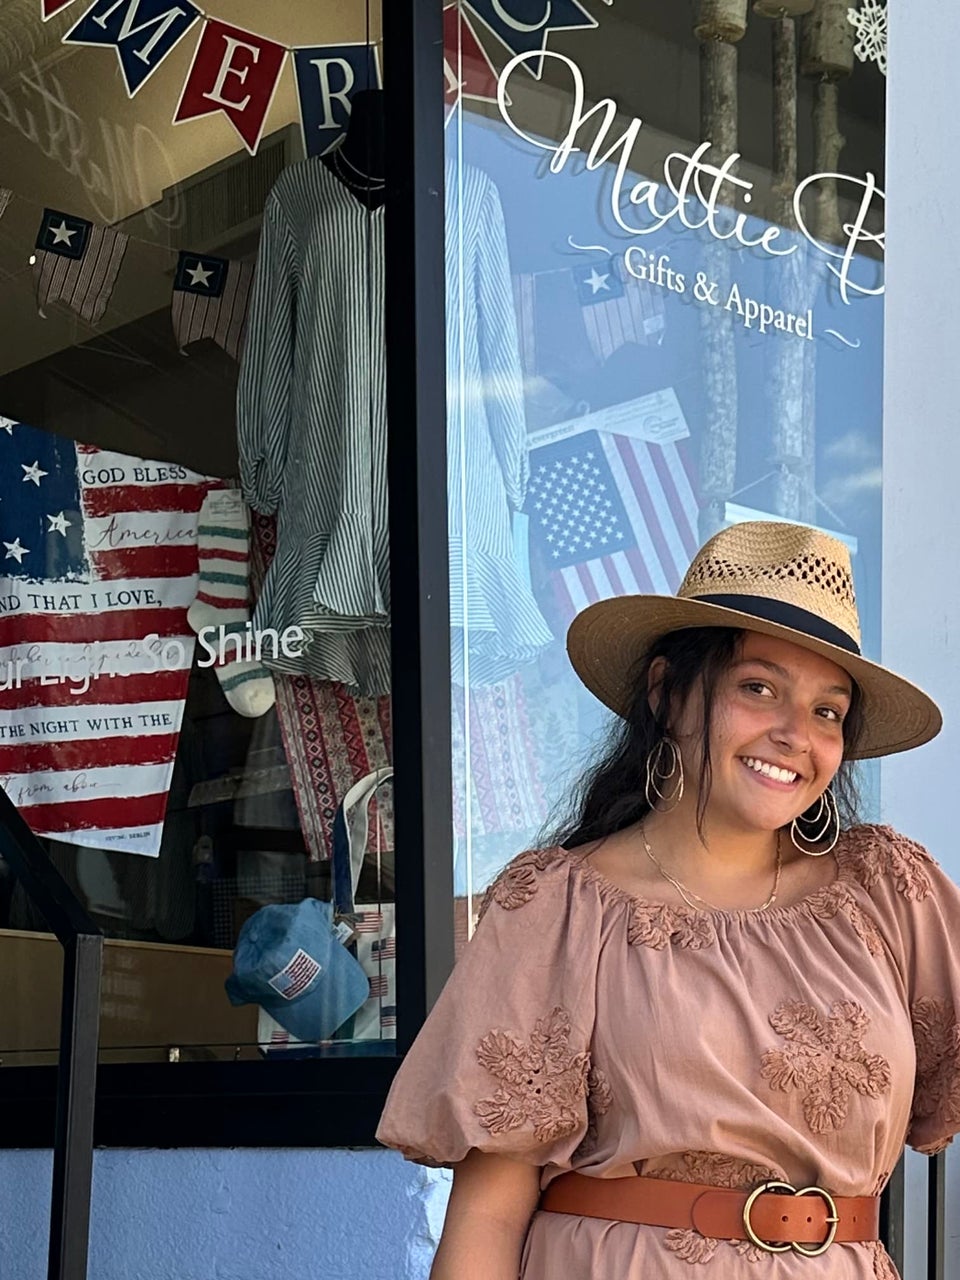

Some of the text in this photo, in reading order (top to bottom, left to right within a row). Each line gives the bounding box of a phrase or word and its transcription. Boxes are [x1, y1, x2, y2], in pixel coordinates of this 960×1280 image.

[497, 50, 798, 256] Mattie
[624, 246, 814, 340] Gifts & Apparel
[83, 465, 188, 485] GOD BLESS
[90, 515, 199, 548] America
[28, 594, 82, 610] THAT
[91, 594, 98, 609] I
[105, 589, 163, 607] LOVE,
[143, 633, 186, 674] So
[197, 621, 304, 668] Shine
[0, 713, 172, 738] THE NIGHT WITH THE
[17, 783, 54, 804] from
